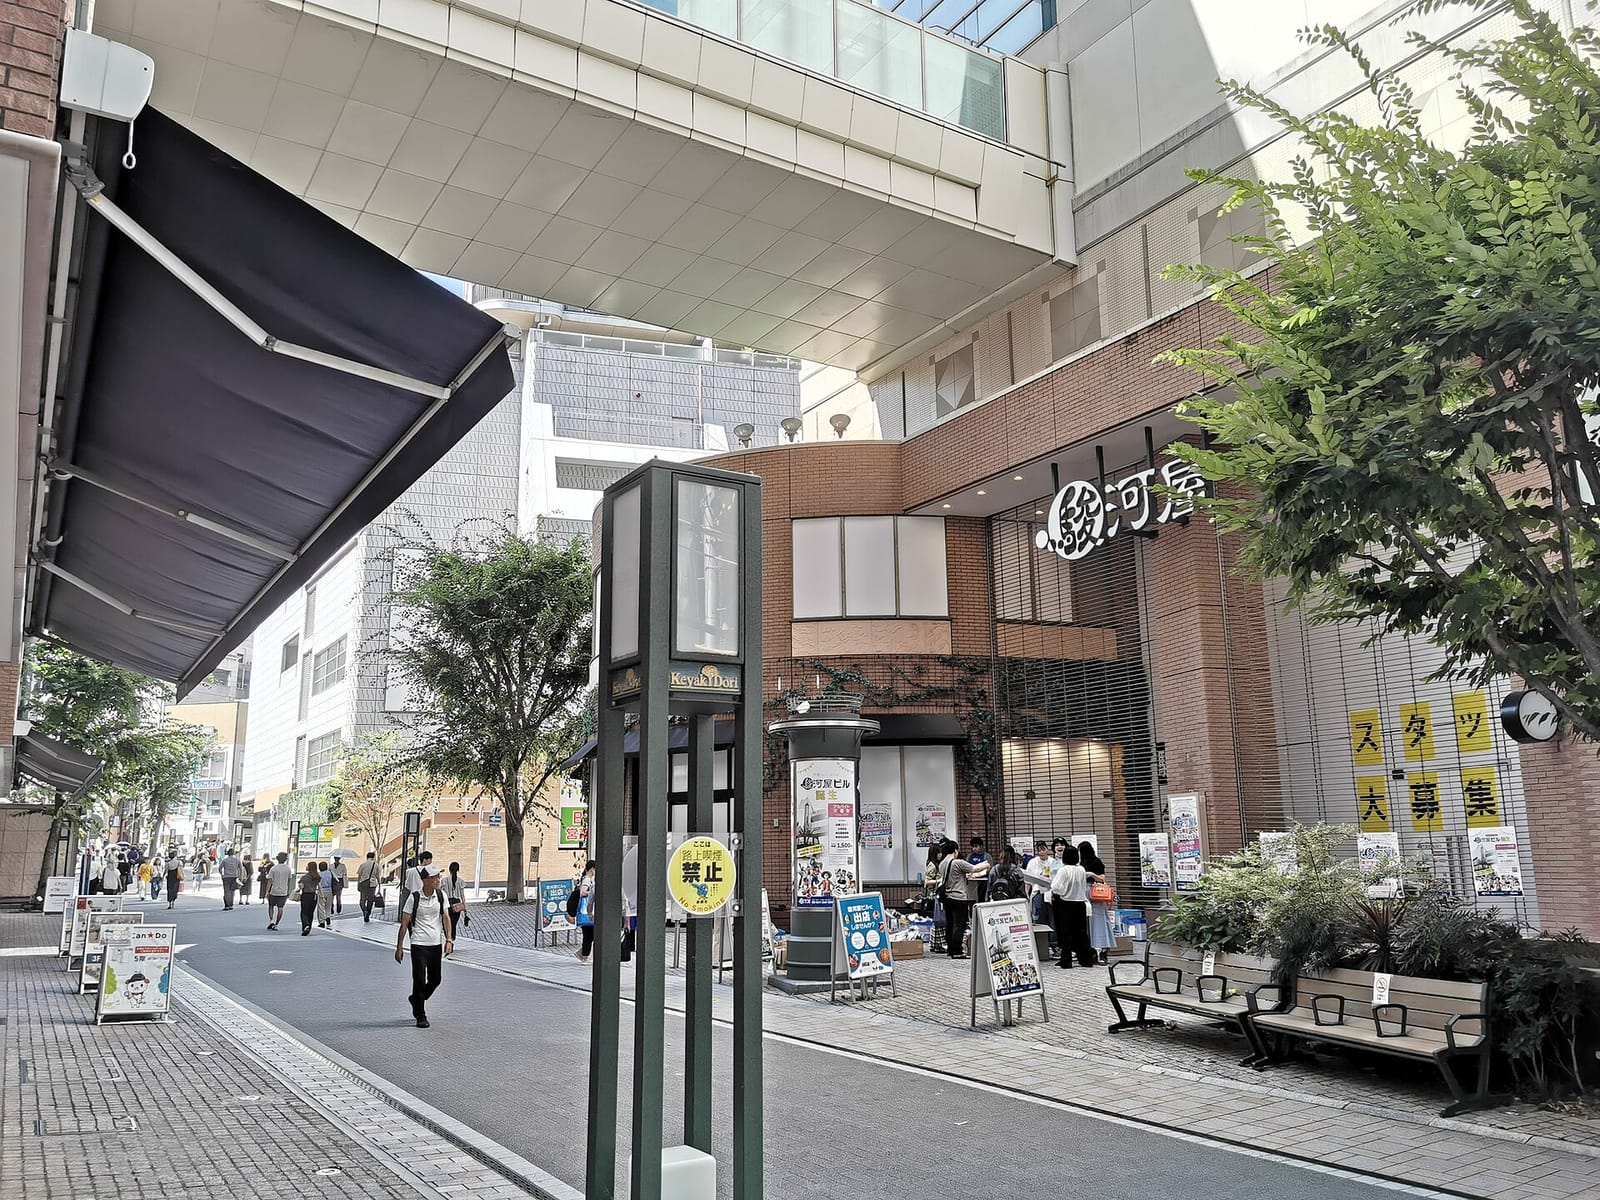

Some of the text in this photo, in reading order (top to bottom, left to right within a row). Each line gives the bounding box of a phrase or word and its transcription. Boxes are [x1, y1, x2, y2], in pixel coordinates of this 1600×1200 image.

[1036, 458, 1207, 560] 駿河屋
[713, 674, 739, 689] Dori
[1359, 778, 1497, 821] 大募集
[682, 849, 723, 861] 路上喫煙
[682, 861, 723, 883] 禁止
[678, 896, 726, 912] No Smoking
[853, 911, 871, 924] 出店
